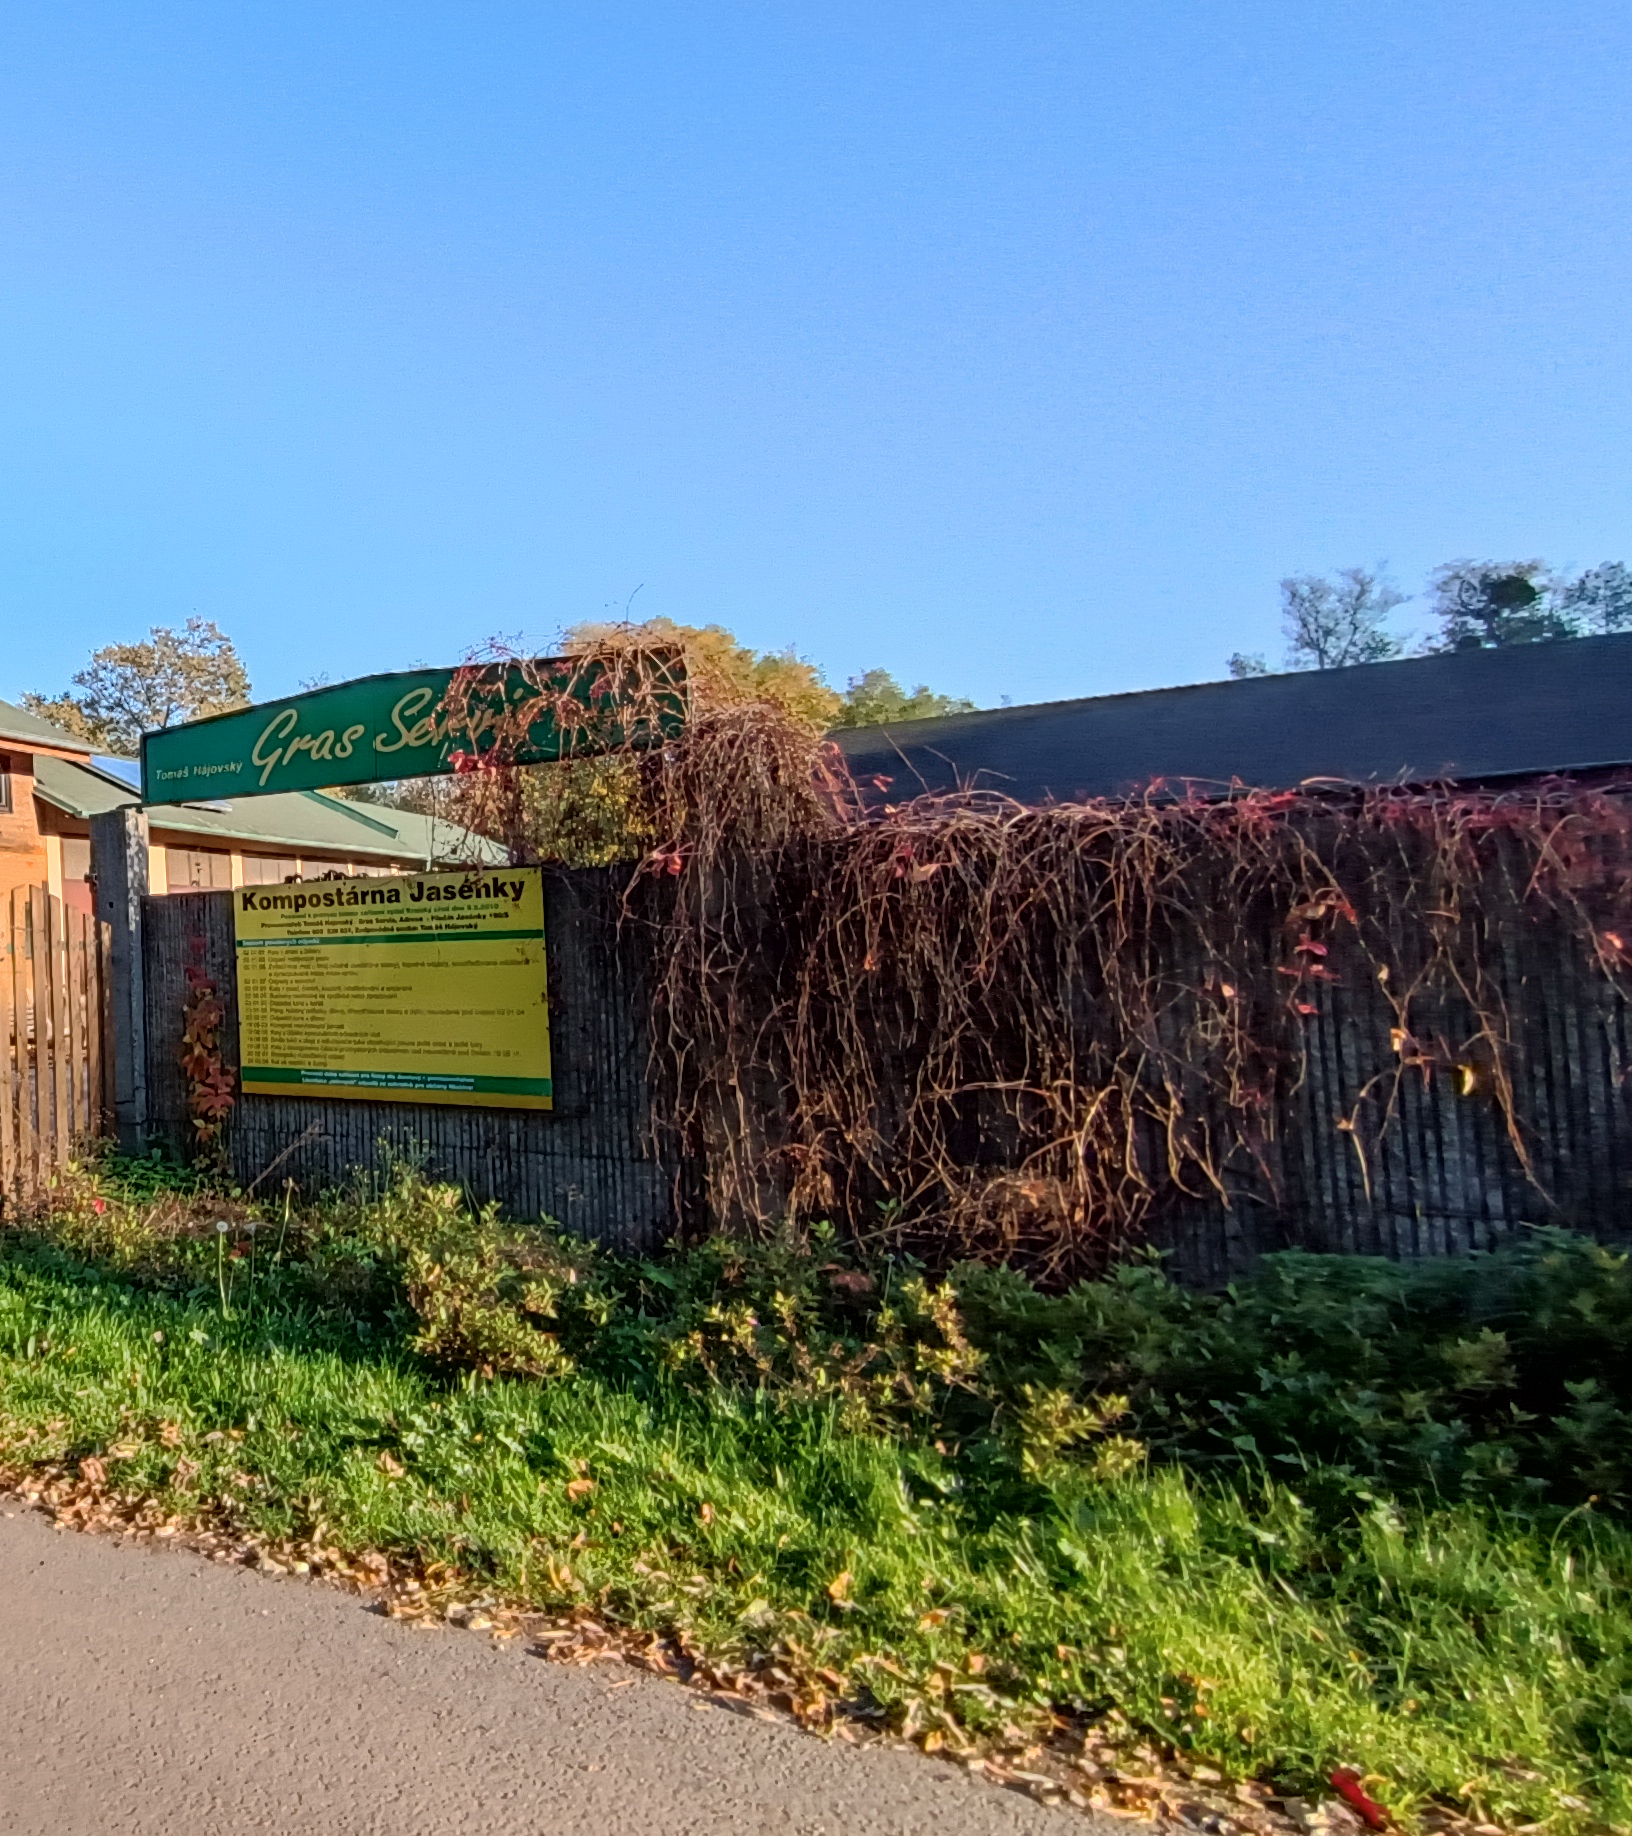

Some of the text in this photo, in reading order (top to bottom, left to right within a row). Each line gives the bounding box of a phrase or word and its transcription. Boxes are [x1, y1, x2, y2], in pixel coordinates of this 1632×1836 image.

[251, 708, 366, 787] Gras
[156, 760, 243, 781] Tomáš Hájovský
[242, 886, 401, 913] Kompostárna
